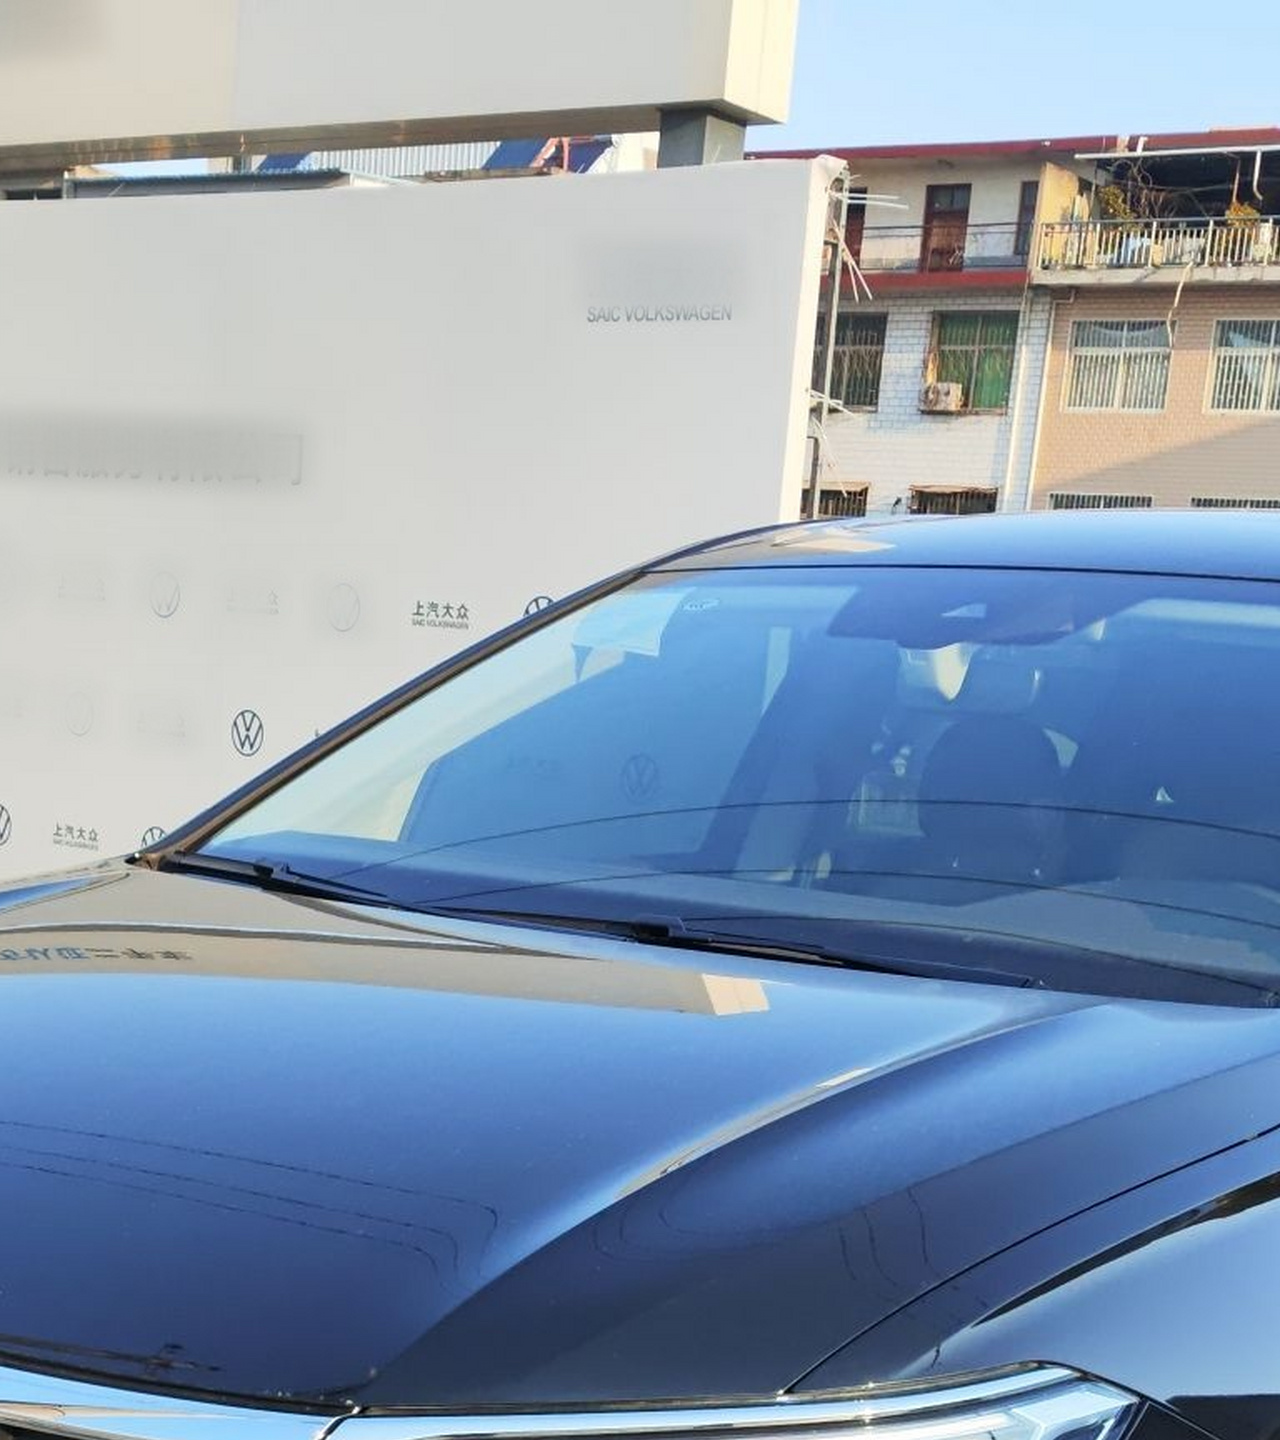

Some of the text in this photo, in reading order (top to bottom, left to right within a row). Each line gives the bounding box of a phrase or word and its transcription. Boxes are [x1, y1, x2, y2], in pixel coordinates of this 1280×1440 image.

[586, 304, 733, 323] SAIC VOLKSWAGEN
[412, 600, 469, 620] 上汽大众
[53, 822, 99, 842] 上汽大众
